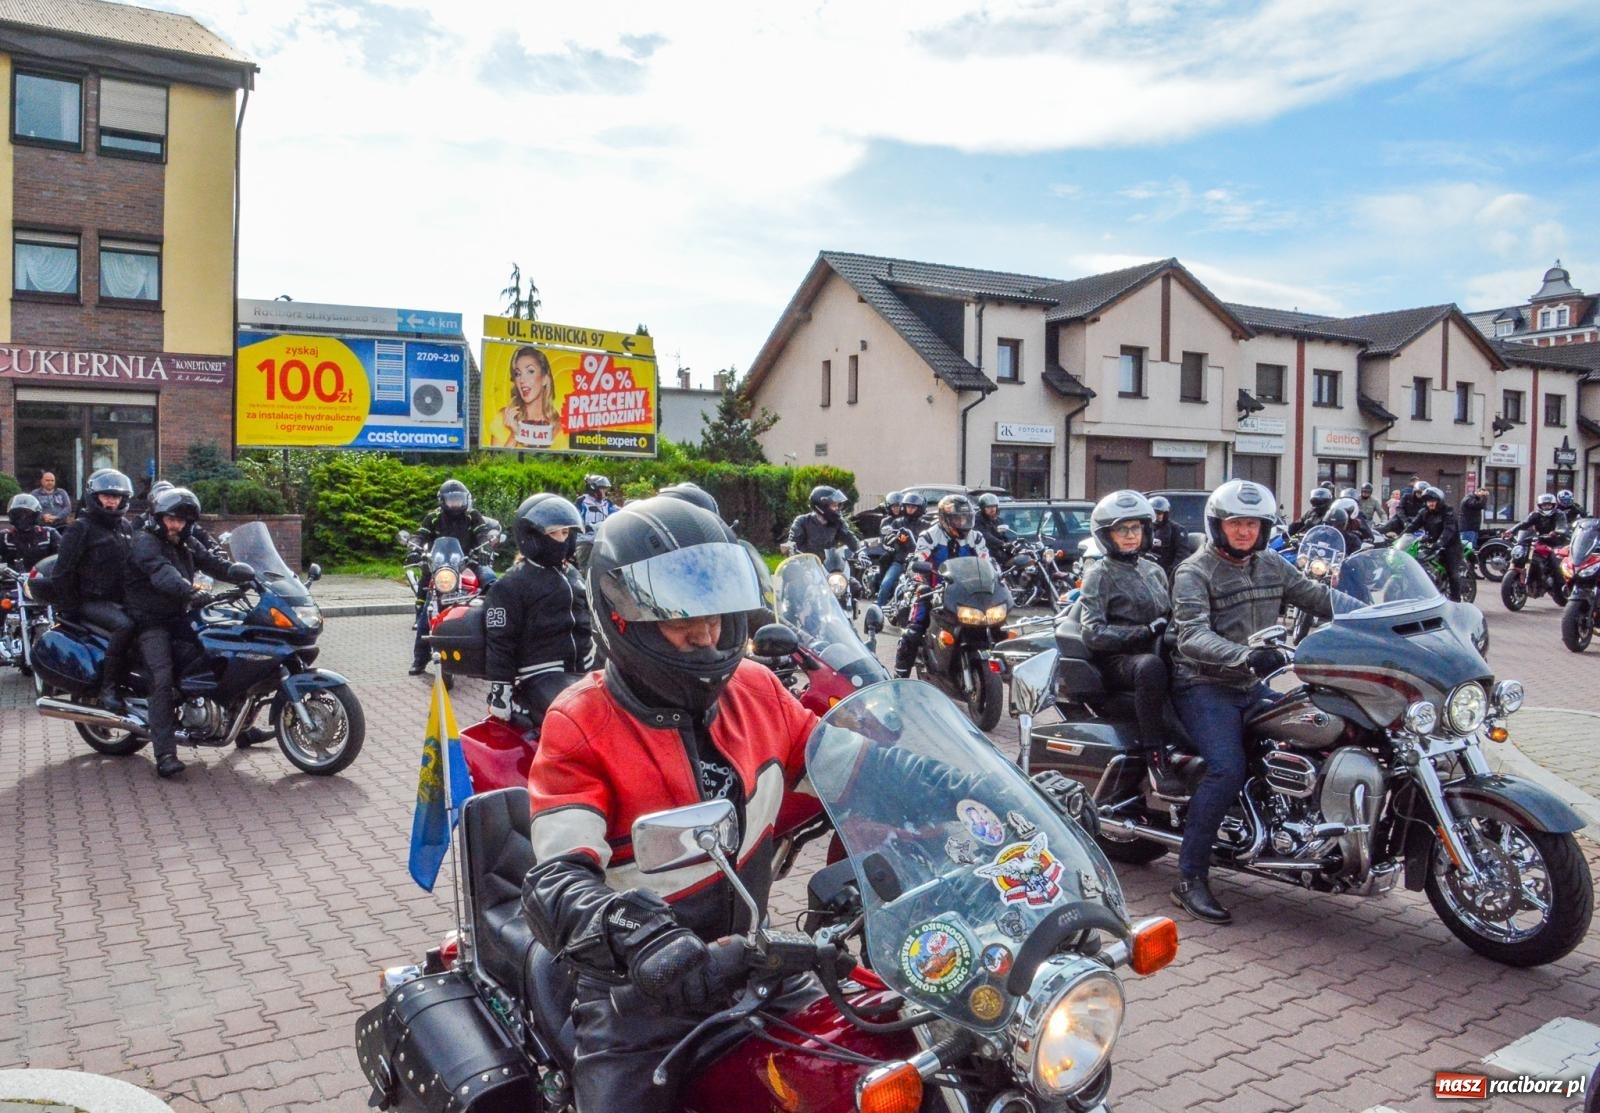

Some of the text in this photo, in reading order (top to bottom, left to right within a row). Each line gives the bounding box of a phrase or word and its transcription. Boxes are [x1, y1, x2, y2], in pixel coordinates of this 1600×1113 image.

[427, 318, 458, 329] 4 km
[507, 321, 605, 348] UL. RYBNICKA 97
[285, 345, 319, 358] zyskaj
[256, 358, 345, 403] 100
[568, 390, 647, 415] PRZECENY
[246, 410, 362, 422] za instalacje hydrauliczne
[568, 409, 645, 429] NA URODZINY!
[280, 423, 334, 432] ogrzewanie
[367, 430, 448, 445] castorama
[576, 434, 638, 448] mediaexpert
[1326, 431, 1361, 445] dentica
[486, 607, 506, 628] 23
